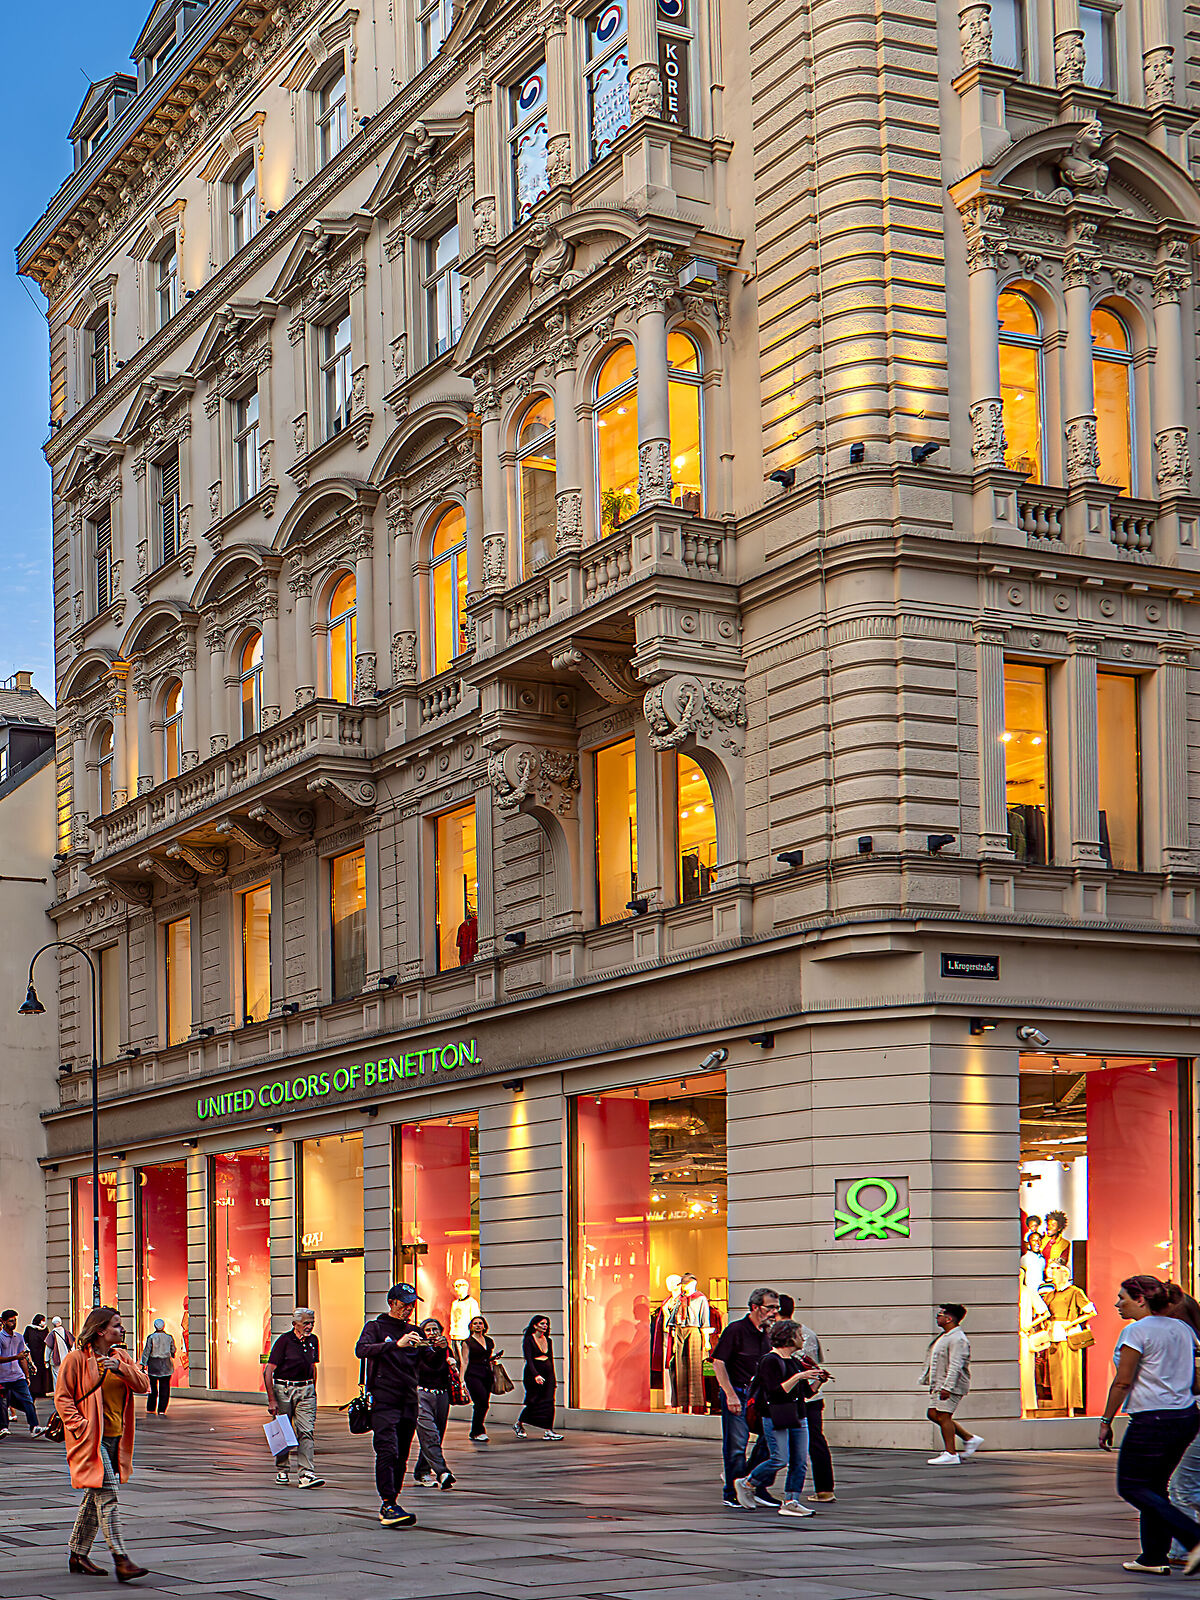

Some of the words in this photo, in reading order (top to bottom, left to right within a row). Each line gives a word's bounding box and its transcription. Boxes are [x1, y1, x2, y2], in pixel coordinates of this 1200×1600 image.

[197, 1088, 255, 1119] UNITED
[258, 1072, 330, 1107] COLORS
[333, 1064, 361, 1093] OF
